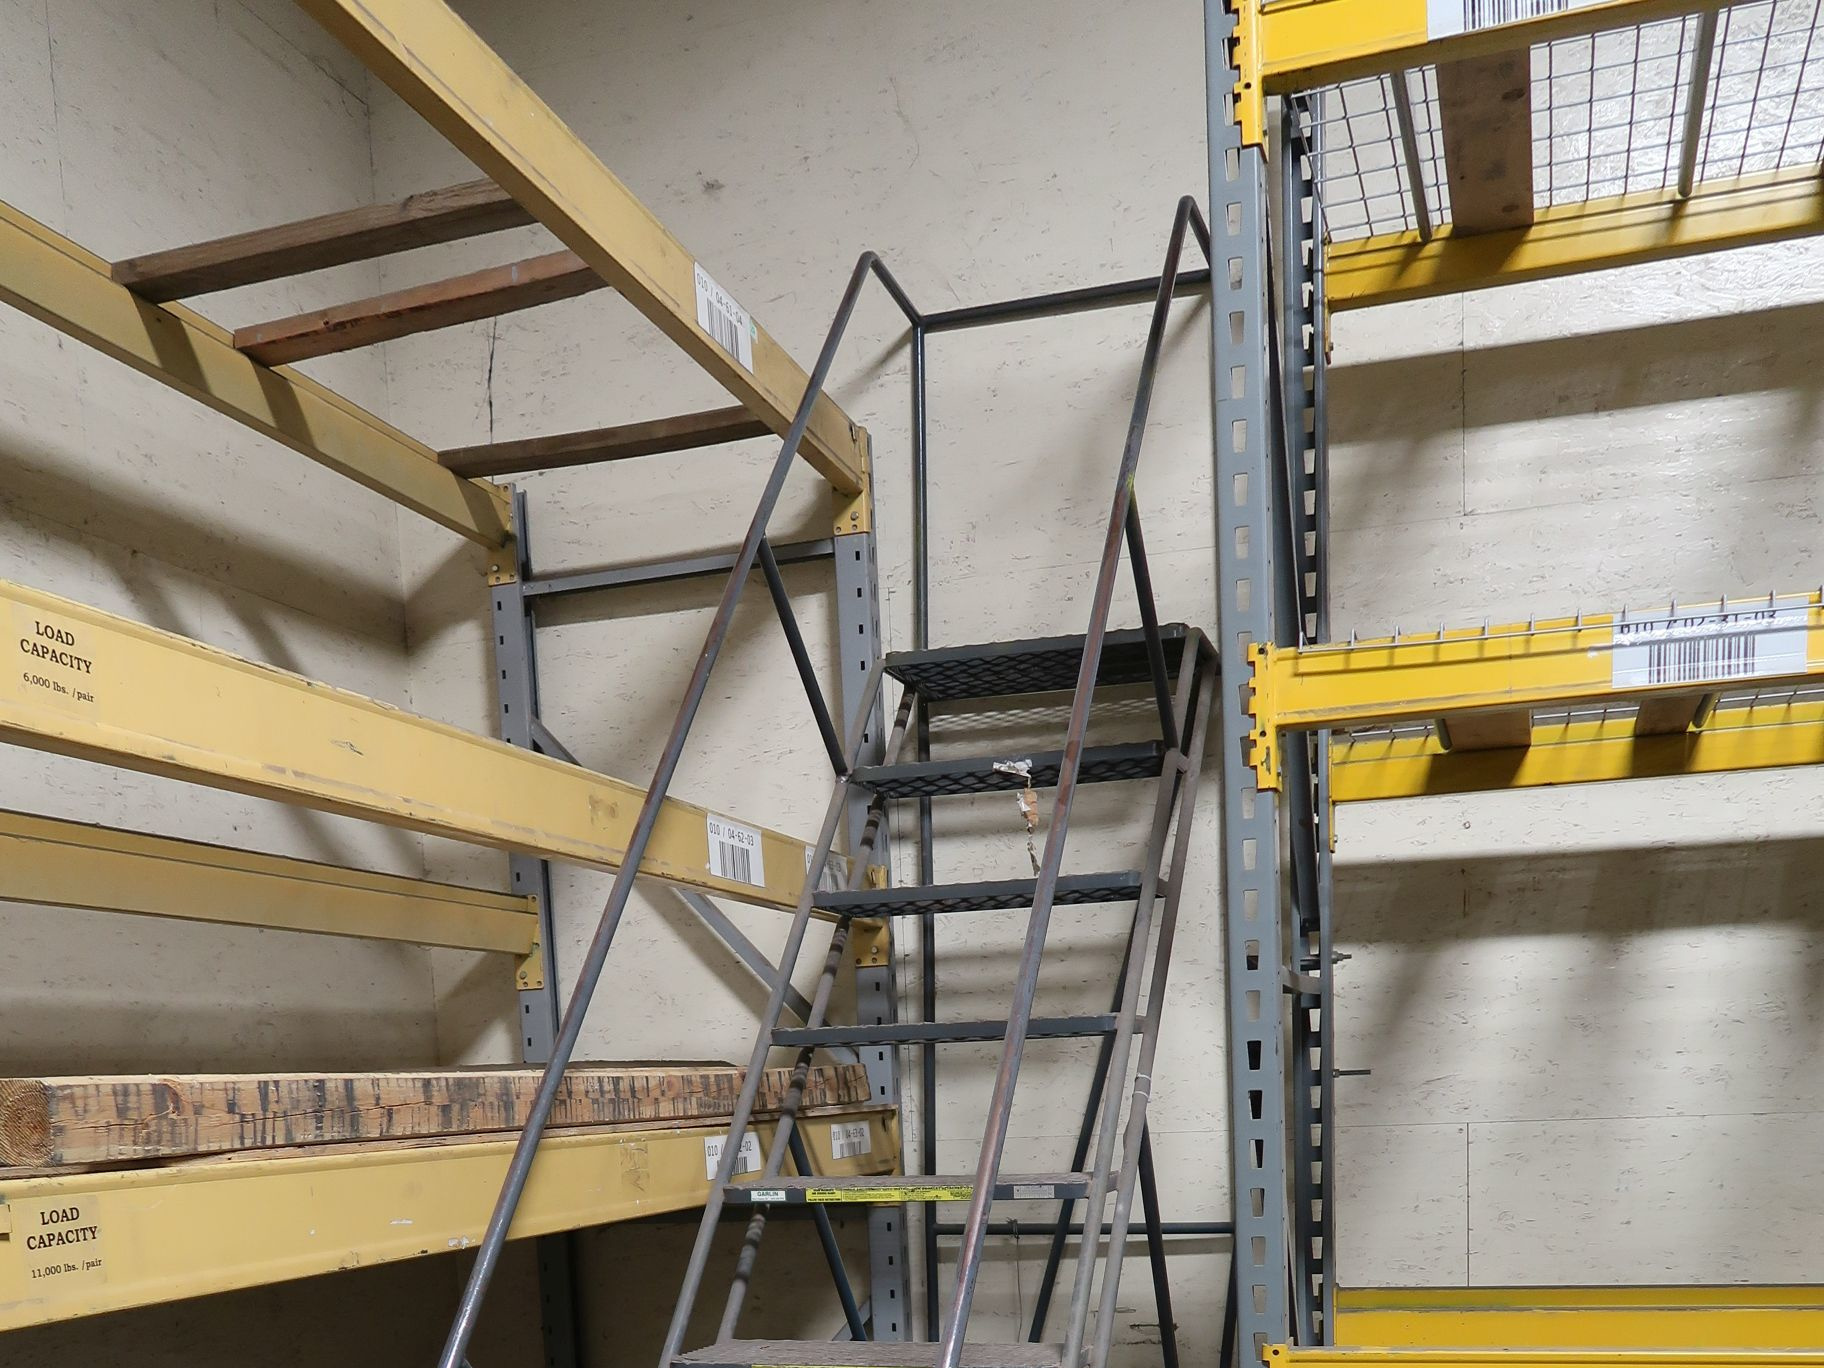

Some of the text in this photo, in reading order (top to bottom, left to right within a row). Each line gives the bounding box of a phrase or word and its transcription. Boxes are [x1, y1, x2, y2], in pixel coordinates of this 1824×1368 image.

[697, 273, 708, 292] 010
[35, 620, 75, 646] LOAD
[20, 638, 92, 674] CAPACITY
[23, 672, 50, 689] 6,000
[53, 681, 69, 695] lbs.
[709, 822, 720, 836] 010
[707, 1144, 719, 1157] 010
[40, 1207, 80, 1225] LOAD
[26, 1225, 98, 1250] CAPACITY
[31, 1264, 62, 1279] 11,000
[64, 1263, 79, 1273] lbs.
